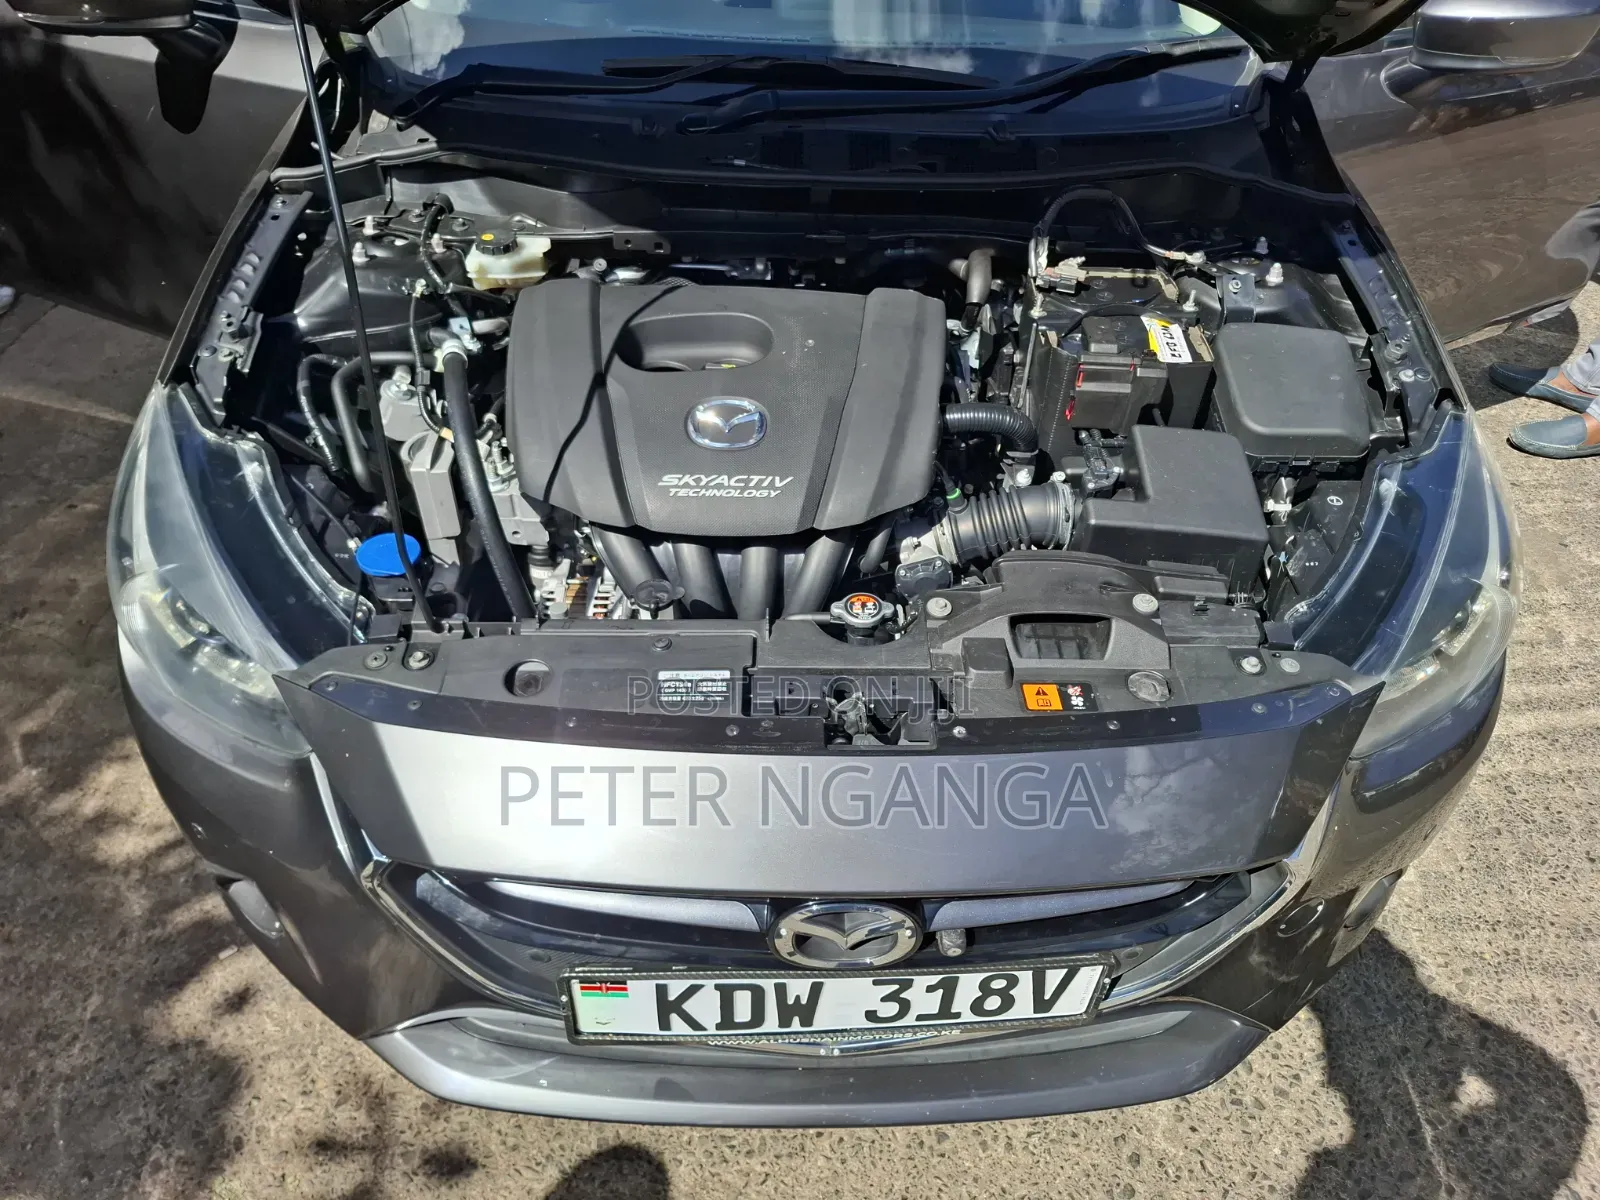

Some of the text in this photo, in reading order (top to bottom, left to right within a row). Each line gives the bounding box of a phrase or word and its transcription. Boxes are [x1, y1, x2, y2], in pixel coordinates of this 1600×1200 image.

[658, 474, 794, 488] SKYACTIV
[669, 488, 782, 498] TECHNOLOGY
[655, 979, 823, 1032] KDW
[864, 966, 1081, 1025] 318V
